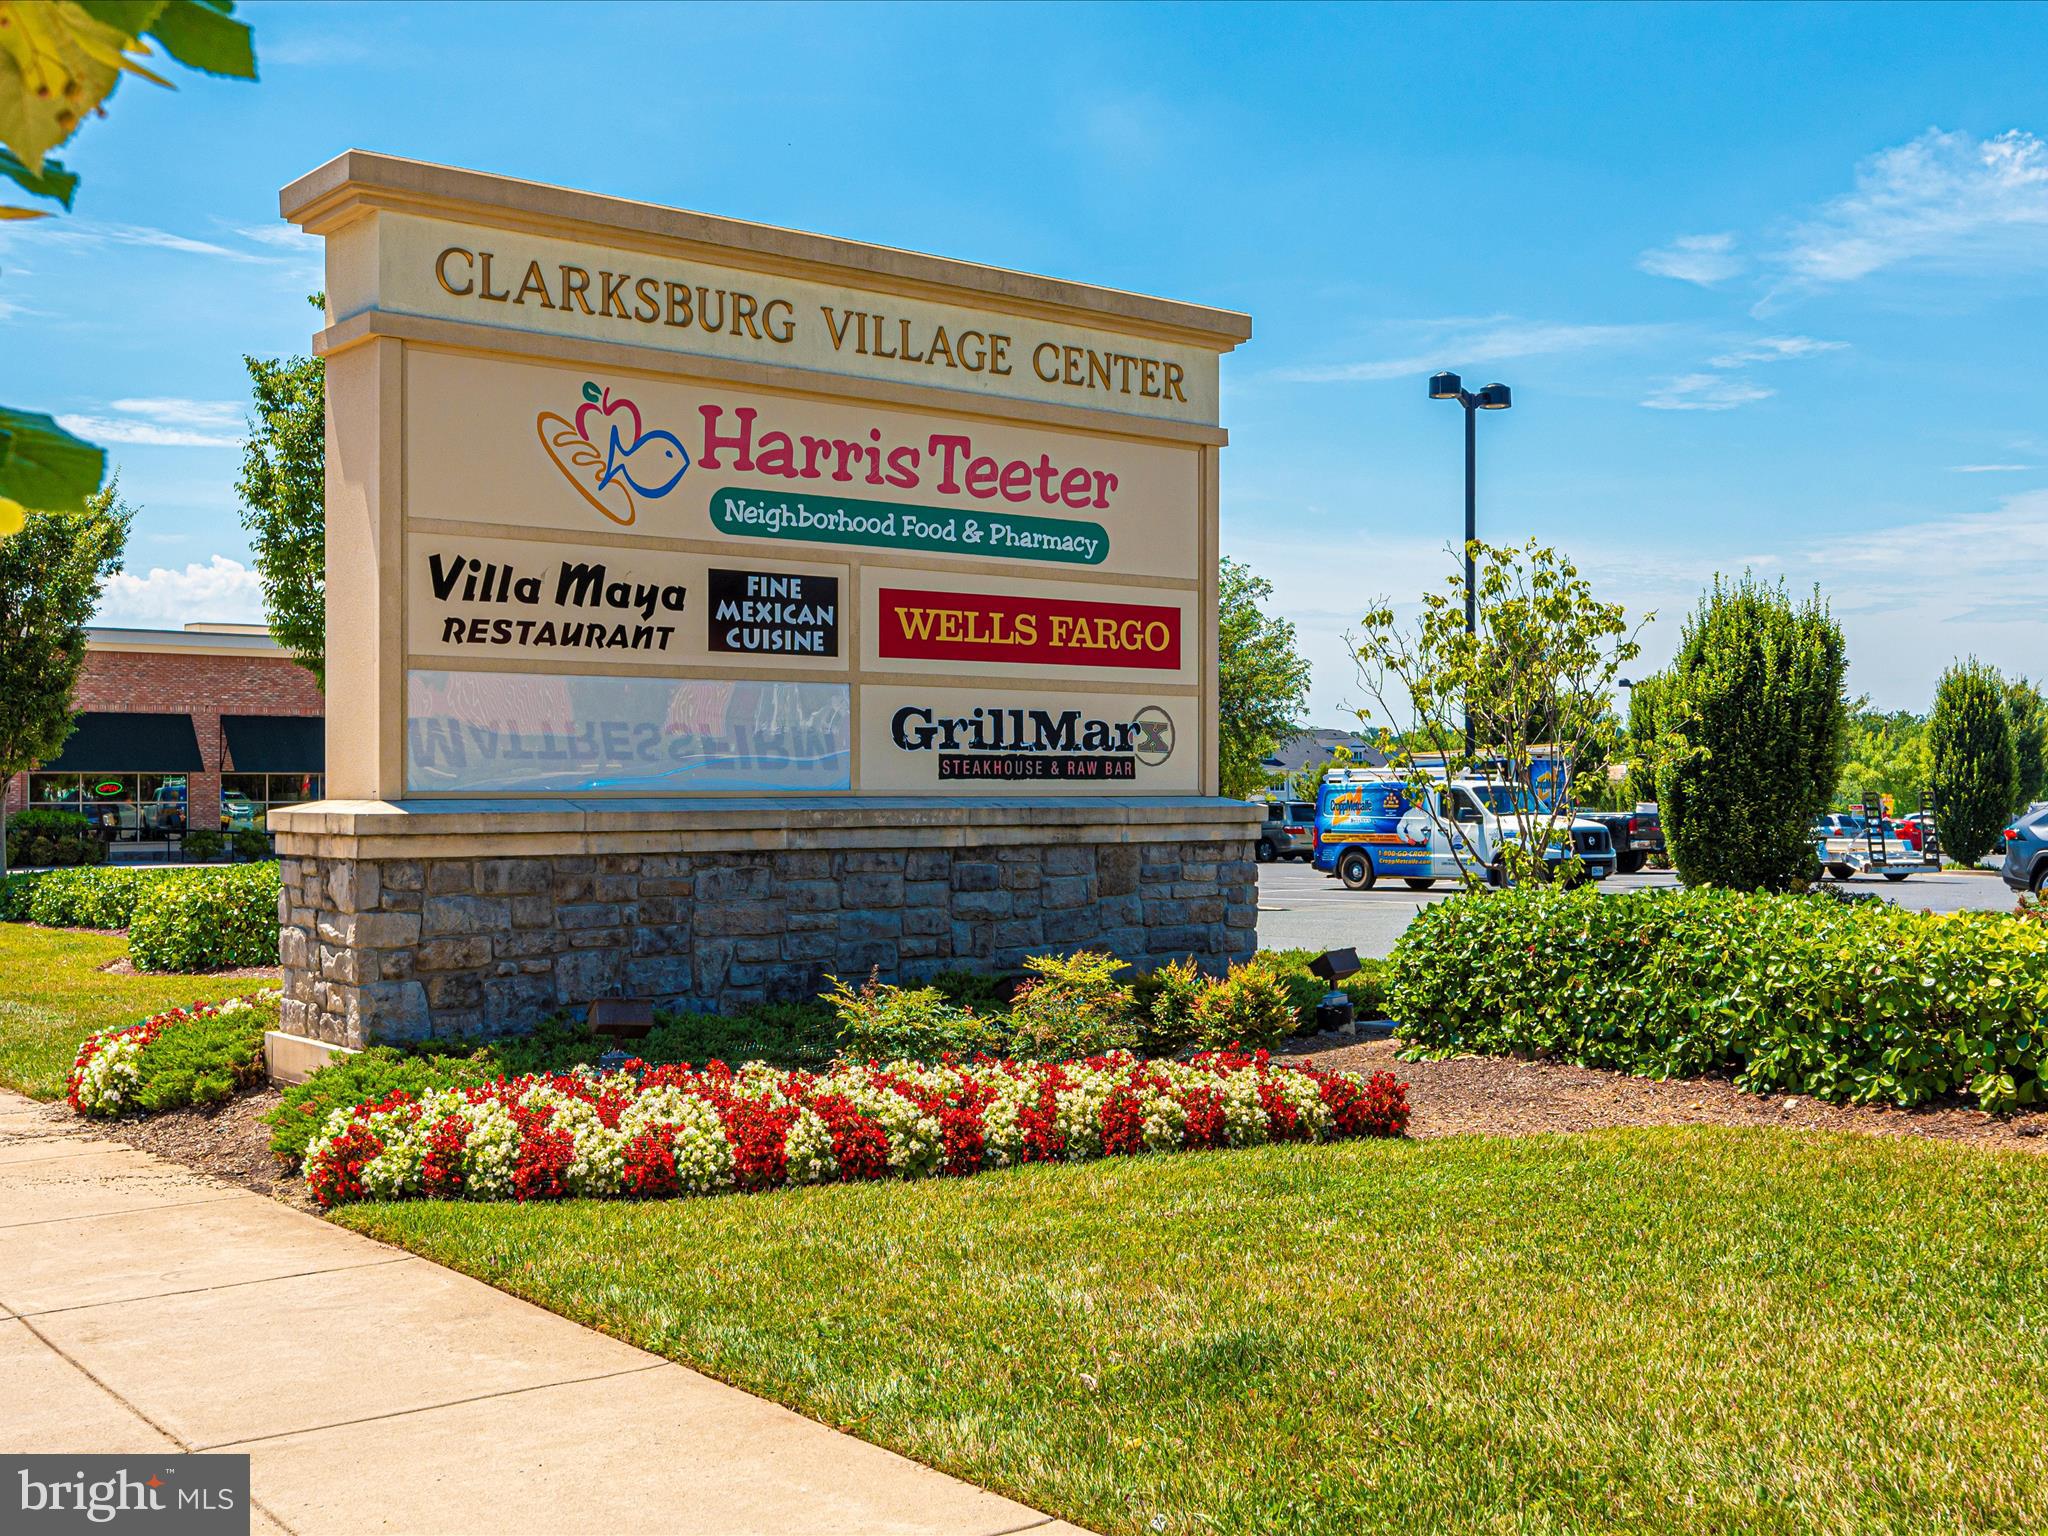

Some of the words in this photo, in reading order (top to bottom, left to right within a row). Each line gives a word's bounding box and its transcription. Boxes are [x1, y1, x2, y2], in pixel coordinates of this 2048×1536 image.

[435, 246, 797, 345] CLARKSBURG
[820, 306, 1013, 377] VILLAGE
[1032, 341, 1188, 403] CENTER
[697, 404, 921, 489] Harris
[928, 433, 1119, 509] Teeter
[724, 498, 896, 537] Neighborhood
[901, 516, 957, 543] Food
[961, 520, 985, 543] &
[989, 523, 1099, 560] Pharmacy
[428, 553, 542, 605] Villa
[554, 561, 688, 622] Maya
[746, 575, 802, 600] FINE
[715, 599, 835, 627] MEXICAN
[894, 607, 1038, 646] WELLS
[1048, 615, 1170, 652] FARGO
[441, 616, 676, 651] RESTAURANT
[726, 627, 826, 652] CUISINE
[942, 759, 1043, 776] STEAKHOUSE
[1050, 760, 1060, 775] &
[1067, 760, 1098, 776] RAW
[1104, 760, 1133, 776] BAR
